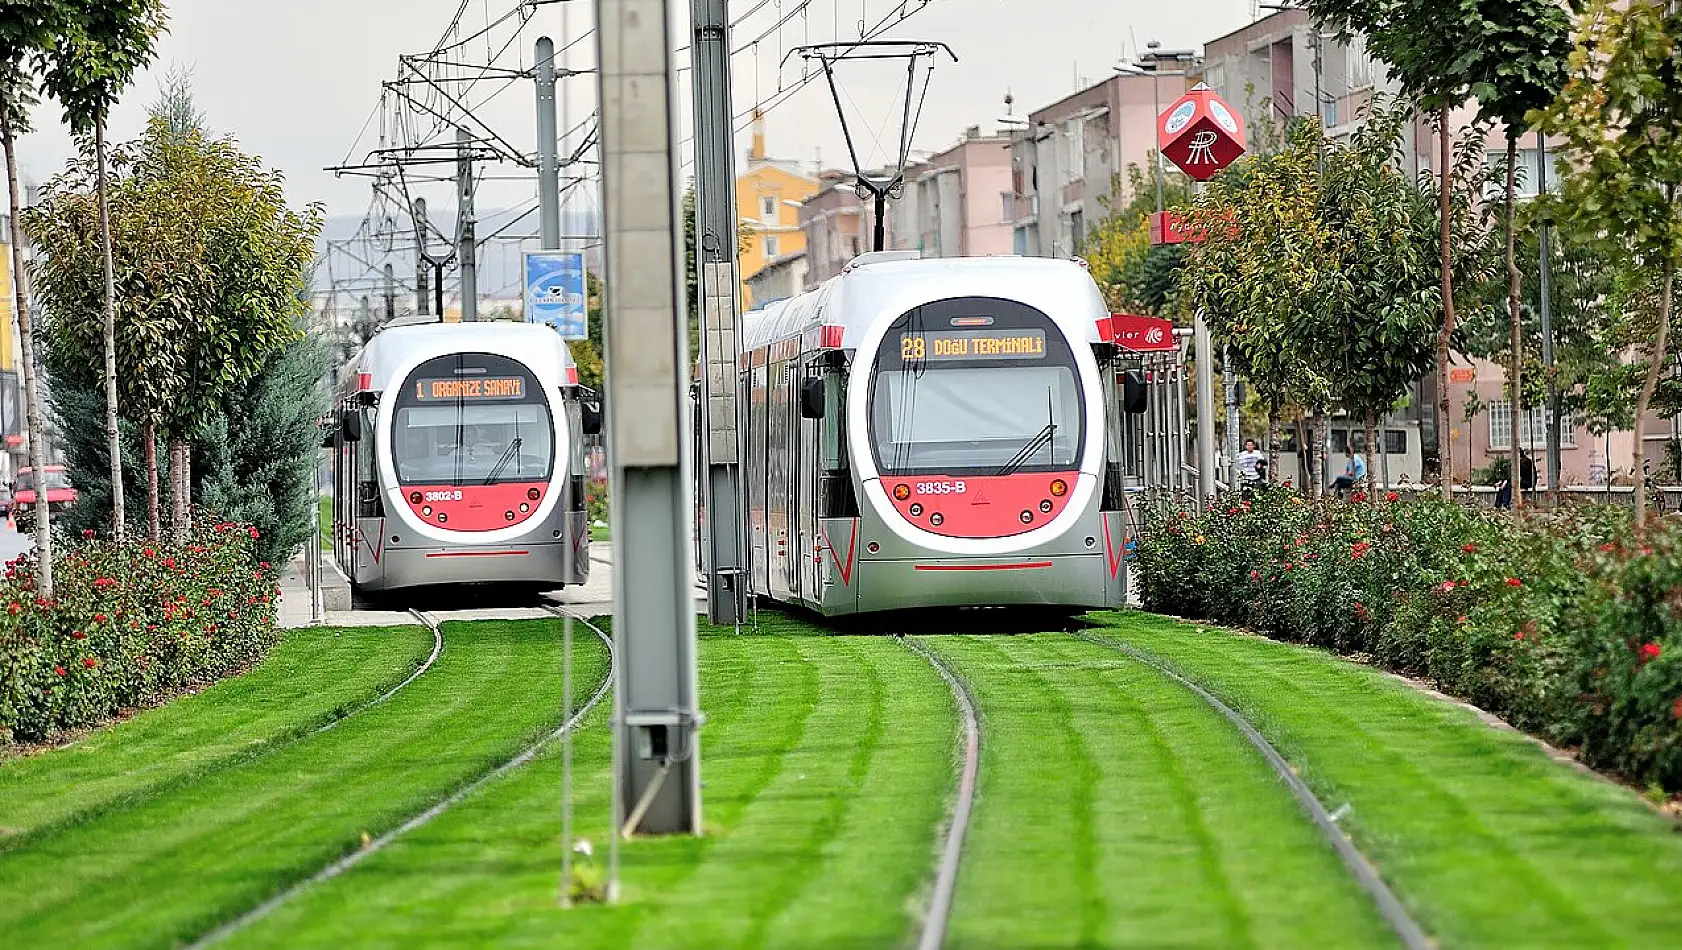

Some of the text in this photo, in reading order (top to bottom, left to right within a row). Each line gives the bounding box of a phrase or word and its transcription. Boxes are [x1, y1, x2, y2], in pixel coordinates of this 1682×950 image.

[902, 336, 1043, 359] 28 DOĞU TERMİNALİ
[416, 382, 424, 398] 1
[483, 379, 521, 397] SANAYİ
[425, 490, 463, 502] 3802-B
[916, 481, 967, 495] 3835-B
